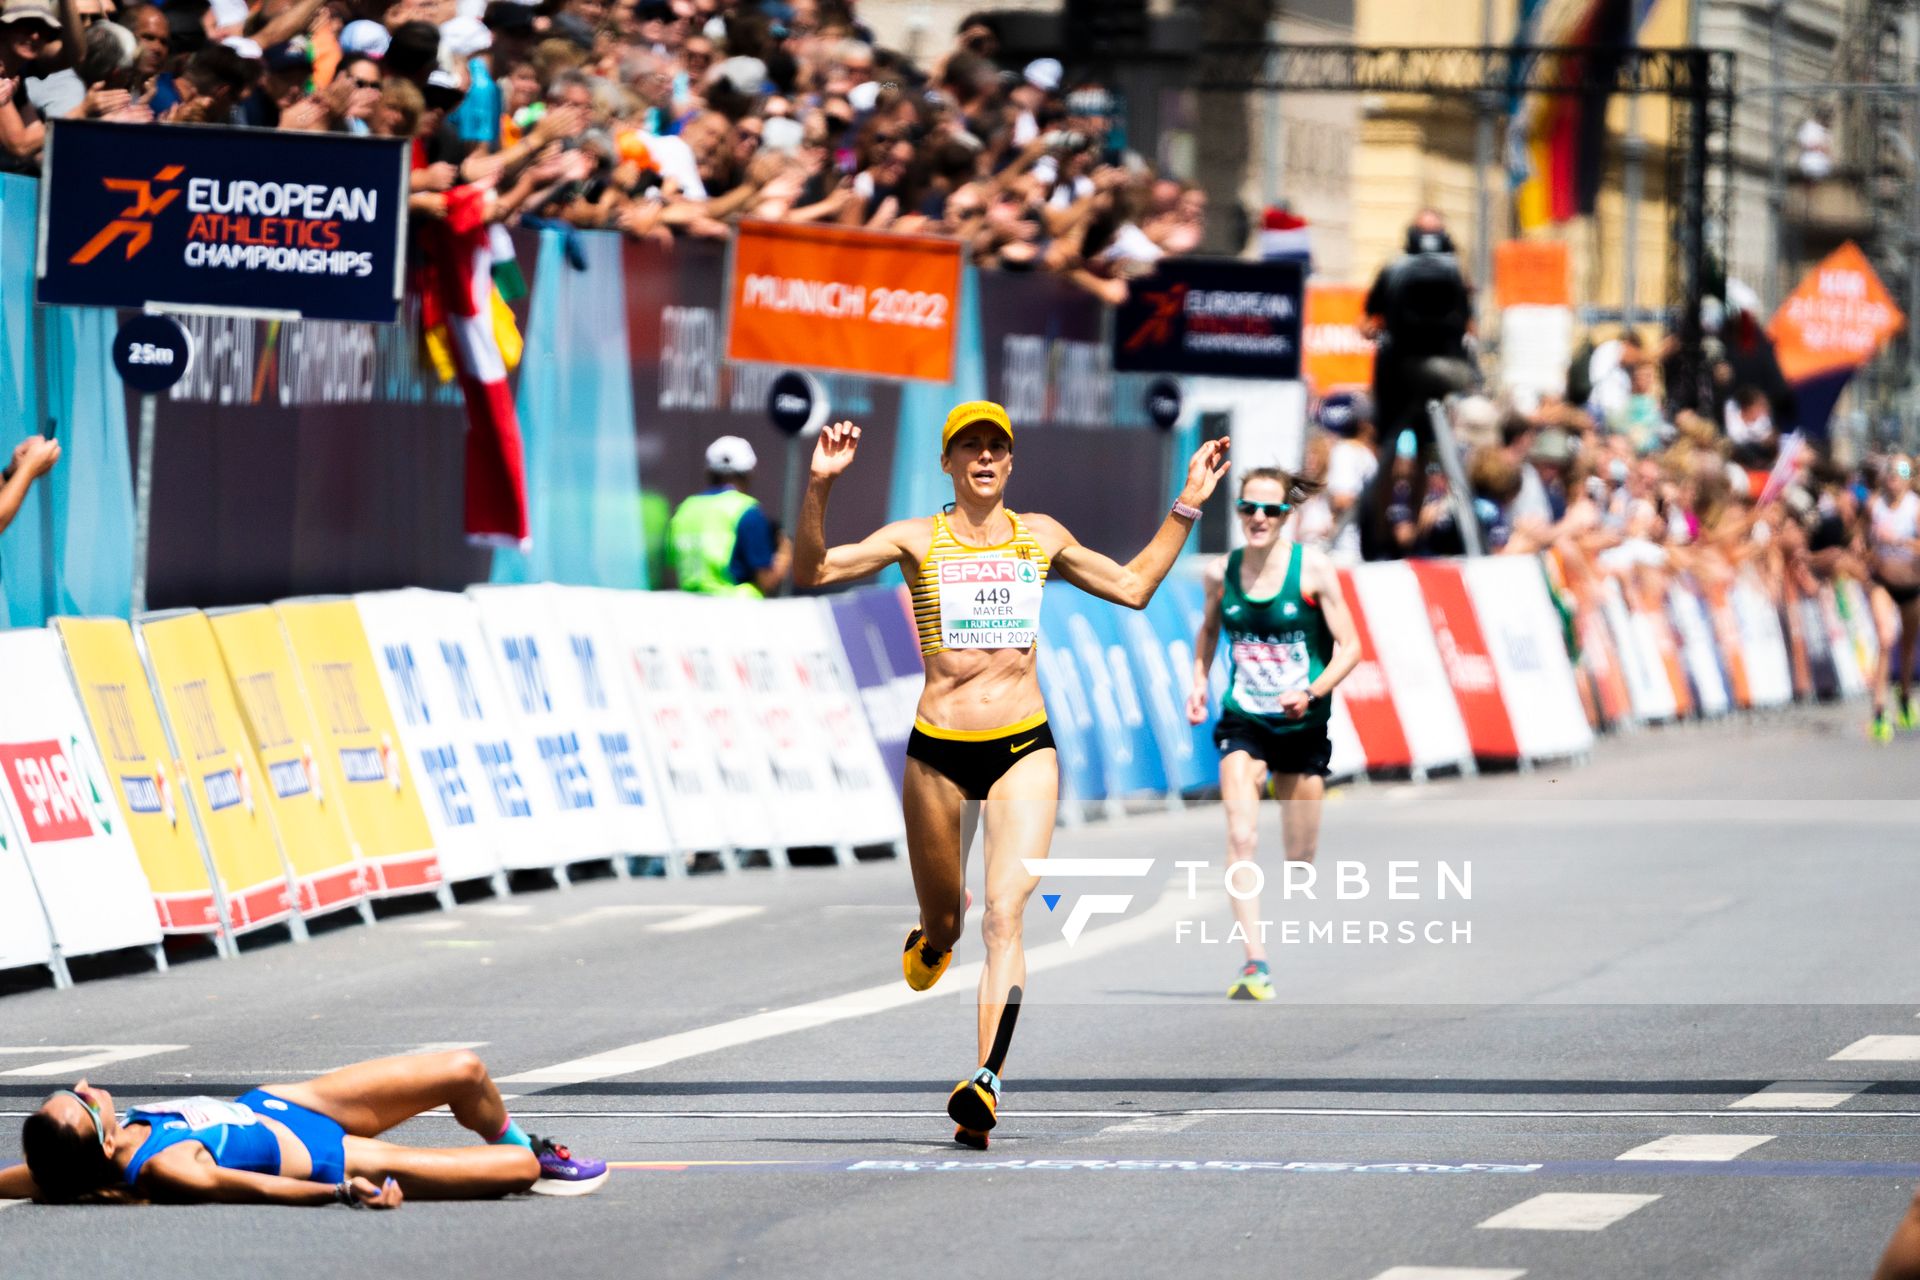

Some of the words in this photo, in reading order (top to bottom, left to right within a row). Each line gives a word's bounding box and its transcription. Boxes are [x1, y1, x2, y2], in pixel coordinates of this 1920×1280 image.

[187, 178, 377, 222] EUROPEAN
[187, 213, 341, 249] ATHLETICS
[184, 242, 373, 277] CHAMPIONSHIPS
[743, 273, 867, 317] MUNICH
[868, 287, 950, 328] 2022
[128, 342, 175, 365] 25m
[943, 563, 1015, 582] SPAR
[974, 588, 1011, 605] 449
[973, 606, 1014, 616] MAYER
[970, 620, 990, 628] RUN
[949, 632, 1003, 645] MUNICH
[15, 754, 88, 827] SPAR
